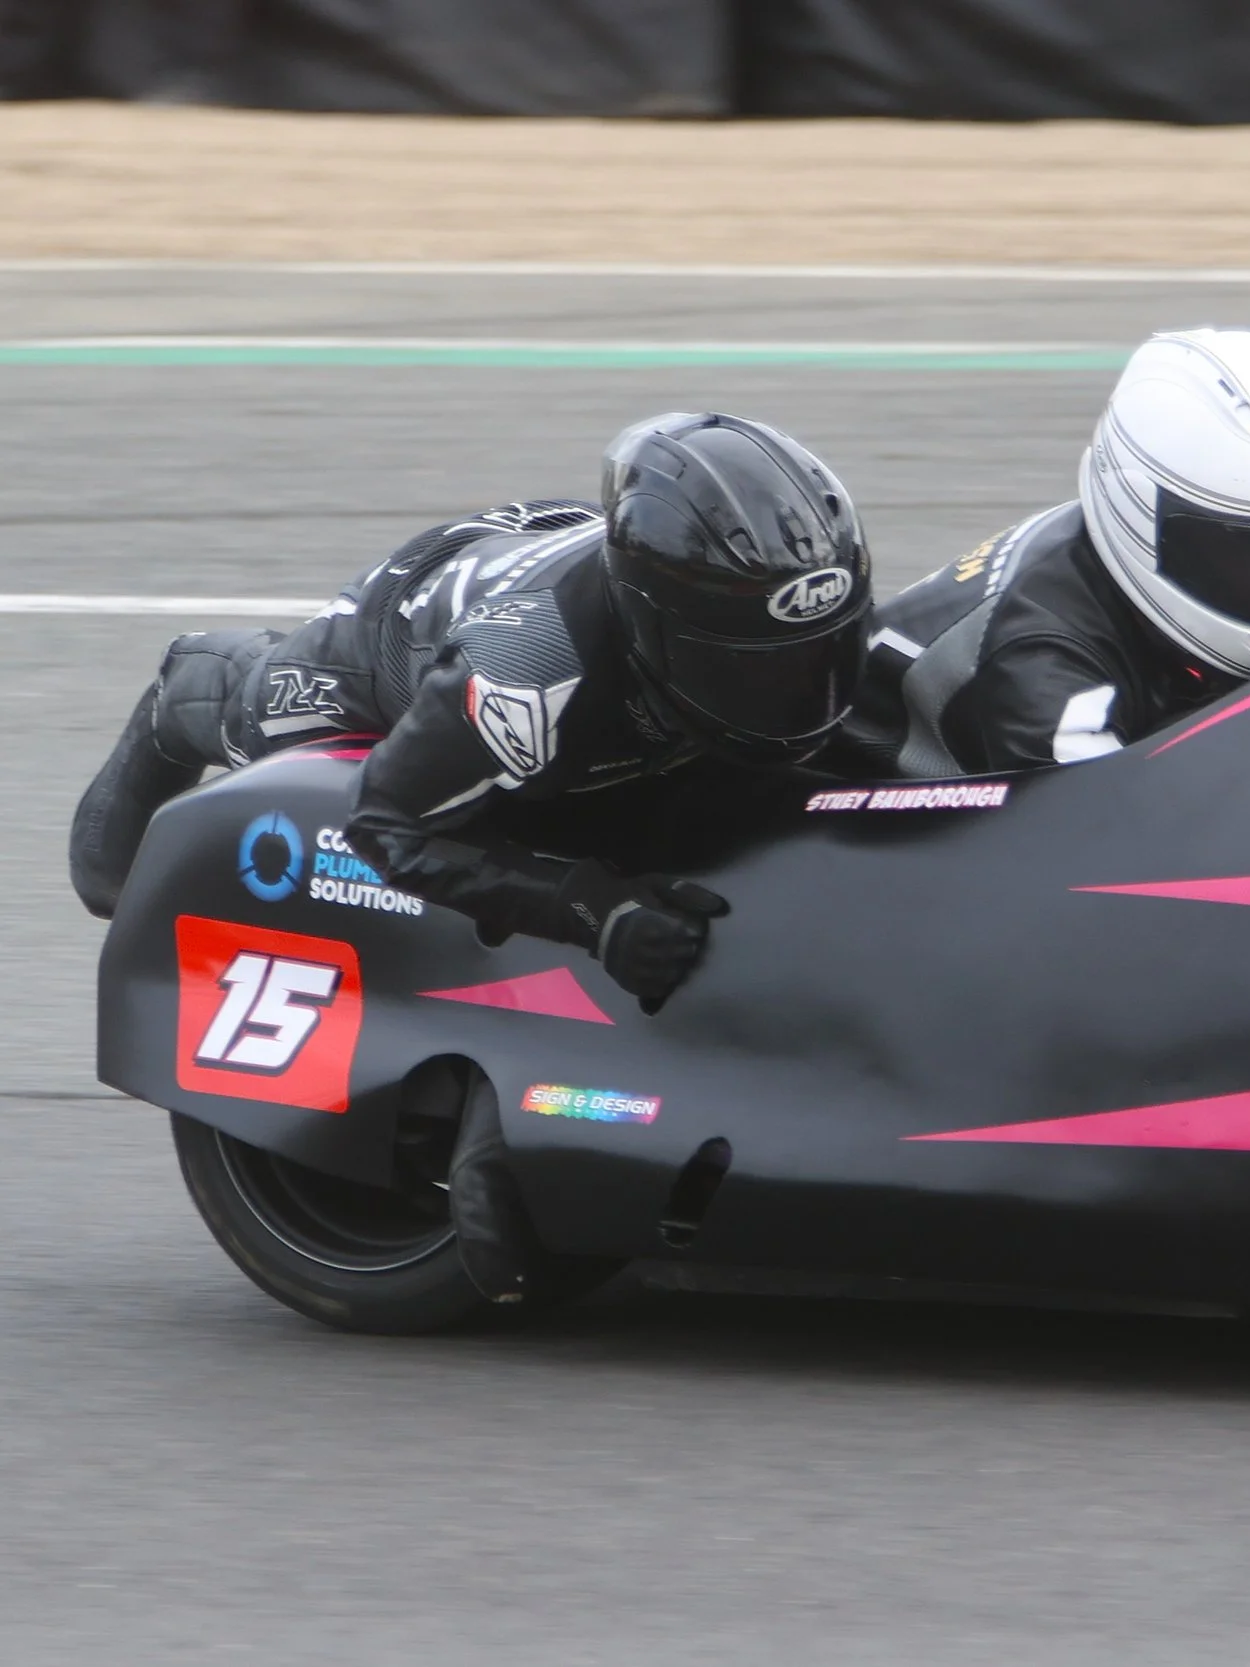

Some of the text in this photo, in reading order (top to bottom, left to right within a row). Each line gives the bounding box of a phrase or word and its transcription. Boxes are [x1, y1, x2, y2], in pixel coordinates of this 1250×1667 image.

[784, 573, 846, 611] Arai
[308, 877, 425, 916] SOLUTIONS
[194, 950, 343, 1075] 15
[528, 1090, 572, 1105] SIGN
[574, 1094, 587, 1108] &
[589, 1096, 657, 1115] DESIGN
